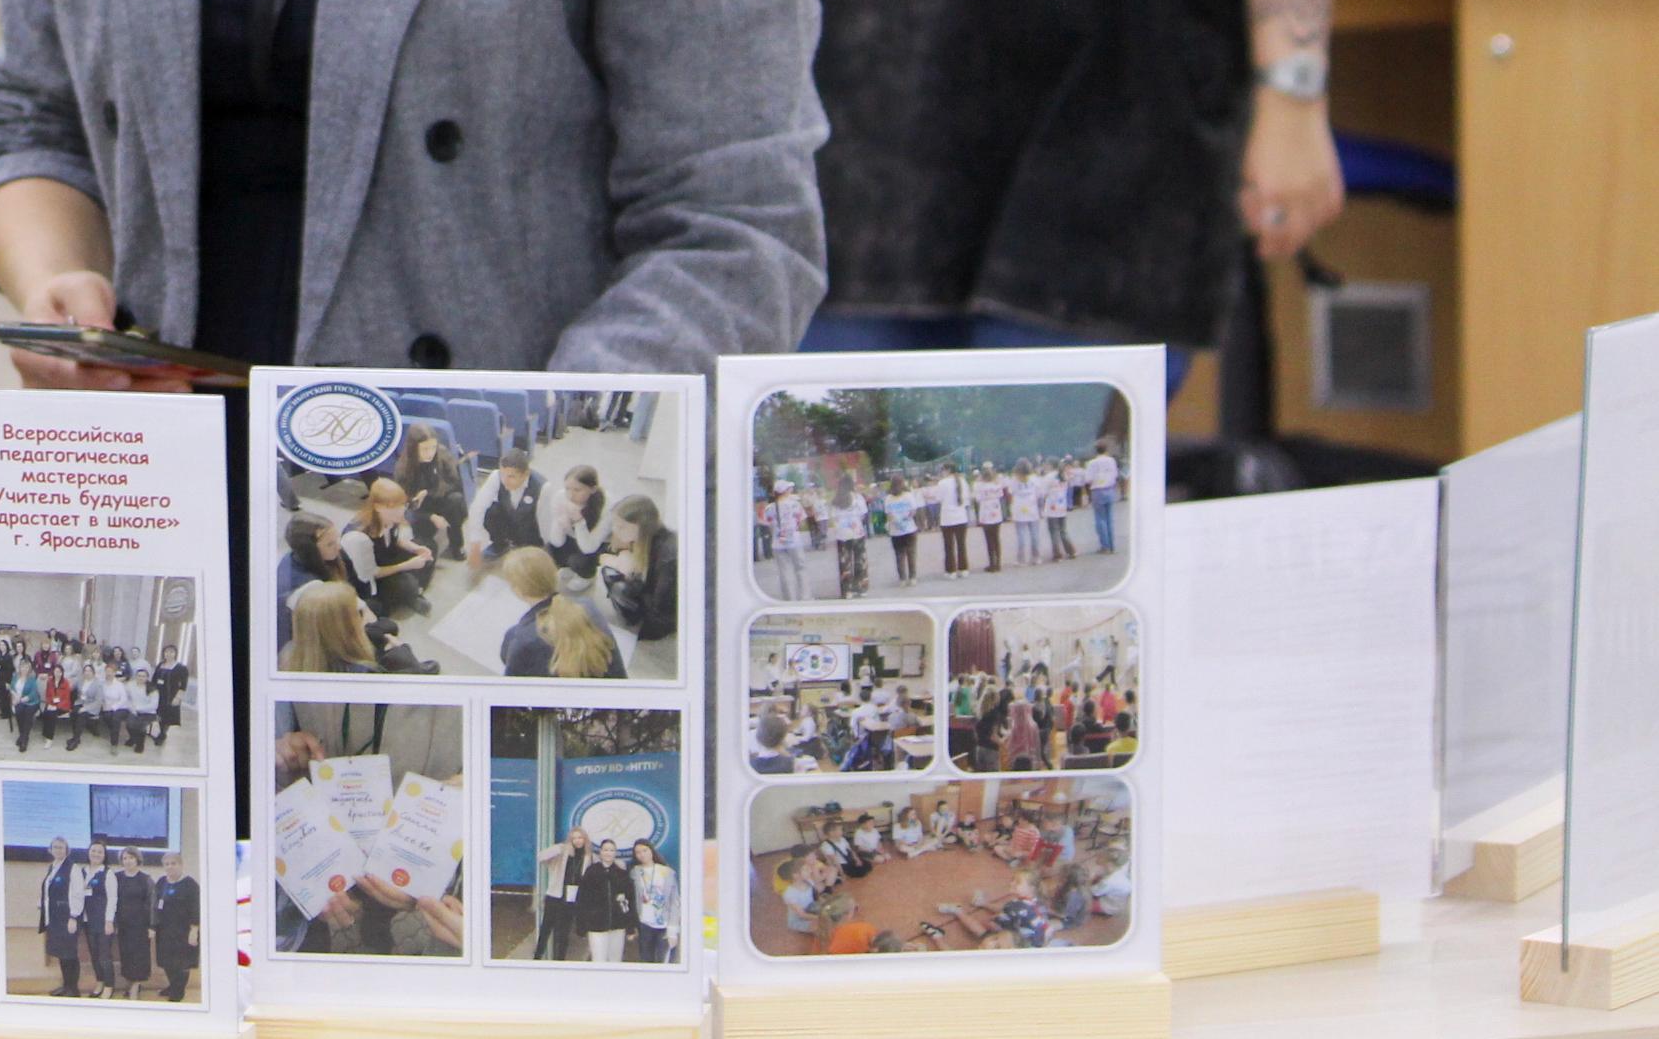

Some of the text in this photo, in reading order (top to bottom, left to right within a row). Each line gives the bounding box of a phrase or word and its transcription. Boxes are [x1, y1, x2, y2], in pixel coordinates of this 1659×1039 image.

[2, 423, 144, 446] Всероссийская
[0, 449, 150, 466] педагогическая
[21, 470, 128, 489] мастерская
[79, 489, 171, 512] будущего
[89, 515, 99, 528] в
[107, 515, 181, 530] школе»
[13, 530, 141, 552] г. Ярославль
